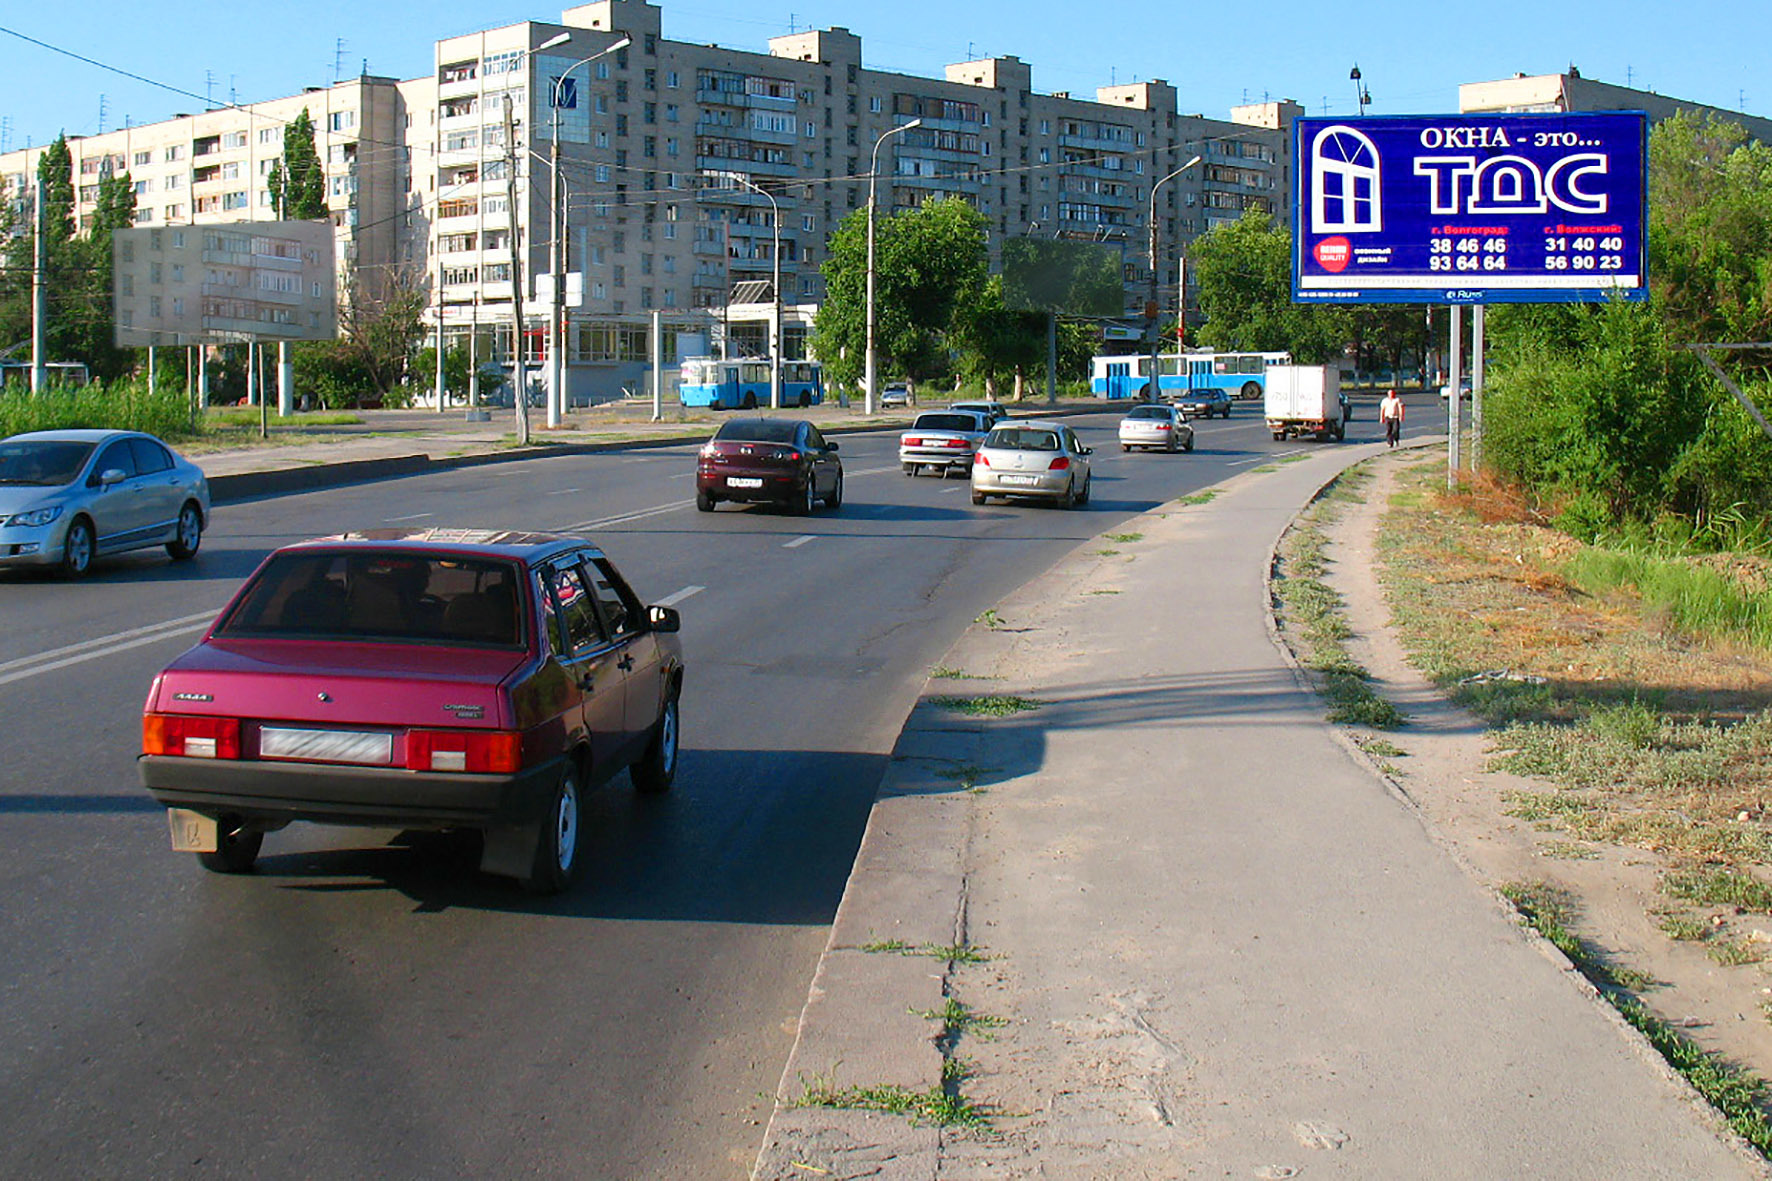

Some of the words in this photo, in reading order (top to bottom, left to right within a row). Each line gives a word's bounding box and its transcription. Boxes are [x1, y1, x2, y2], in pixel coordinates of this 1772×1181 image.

[1420, 127, 1510, 148] ОКНА
[1534, 131, 1602, 147] это...
[1413, 153, 1608, 214] ТДС
[1430, 238, 1452, 253] 38
[1456, 238, 1479, 253] 46
[1483, 238, 1506, 253] 46
[1545, 237, 1566, 251] 31
[1572, 237, 1595, 251] 40
[1599, 237, 1622, 251] 40
[1430, 255, 1452, 270] 93
[1456, 255, 1479, 270] 64
[1483, 255, 1506, 270] 64
[1545, 255, 1567, 269] 56
[1572, 255, 1595, 269] 90
[1599, 255, 1622, 269] 23
